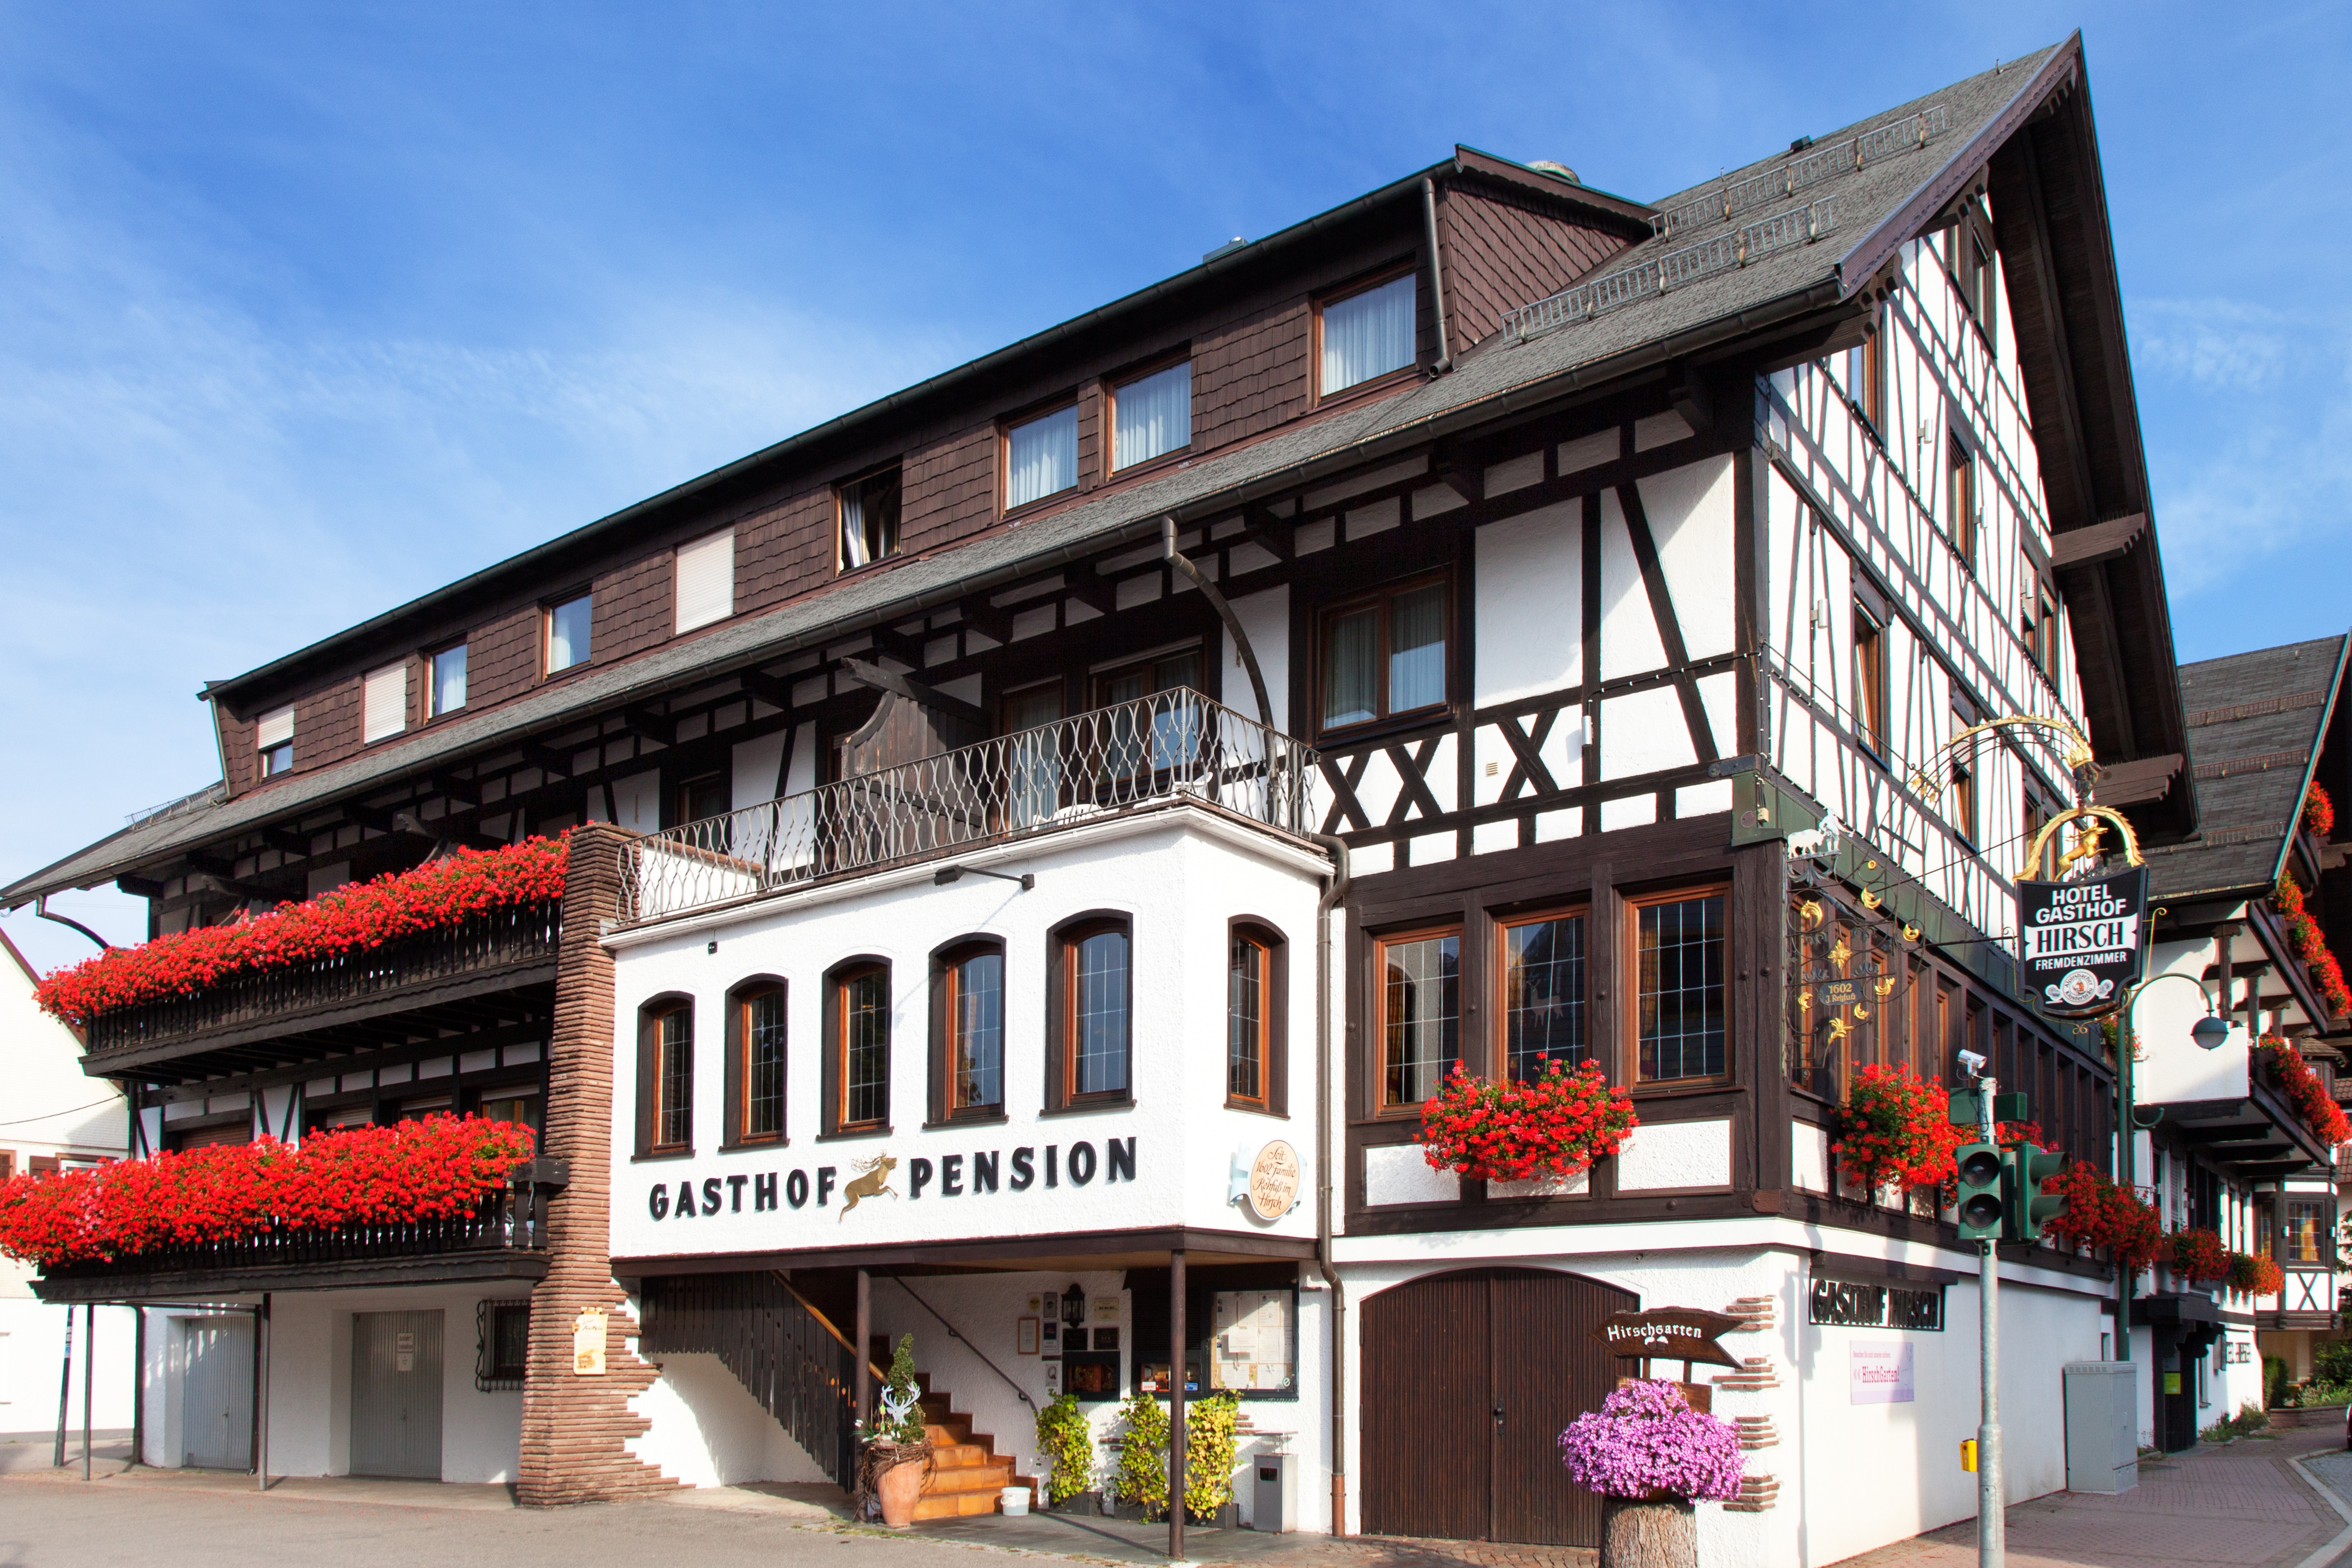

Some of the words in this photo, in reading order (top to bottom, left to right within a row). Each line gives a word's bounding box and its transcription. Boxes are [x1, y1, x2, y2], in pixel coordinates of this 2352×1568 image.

[2052, 884, 2112, 905] HOTEL
[2036, 898, 2127, 924] GASTHOF
[2036, 921, 2124, 953] HIRSCH
[2035, 951, 2127, 971] FREMDENZIMMER
[1828, 983, 1852, 994] 1602
[2064, 973, 2093, 987] Alpirsbacher
[1268, 1147, 1287, 1161] Seit
[649, 1166, 837, 1220] GASTHOF
[910, 1137, 1137, 1198] PENSION
[1256, 1160, 1273, 1175] 1602
[1268, 1162, 1297, 1179] Familie
[1253, 1176, 1282, 1197] Rehfuß
[1283, 1182, 1294, 1198] im
[1258, 1192, 1282, 1211] Hirsch
[1812, 1279, 1887, 1323] GASTHOF
[1888, 1288, 1939, 1328] HIRSCH
[1862, 1366, 1900, 1383] HirschGarten!
